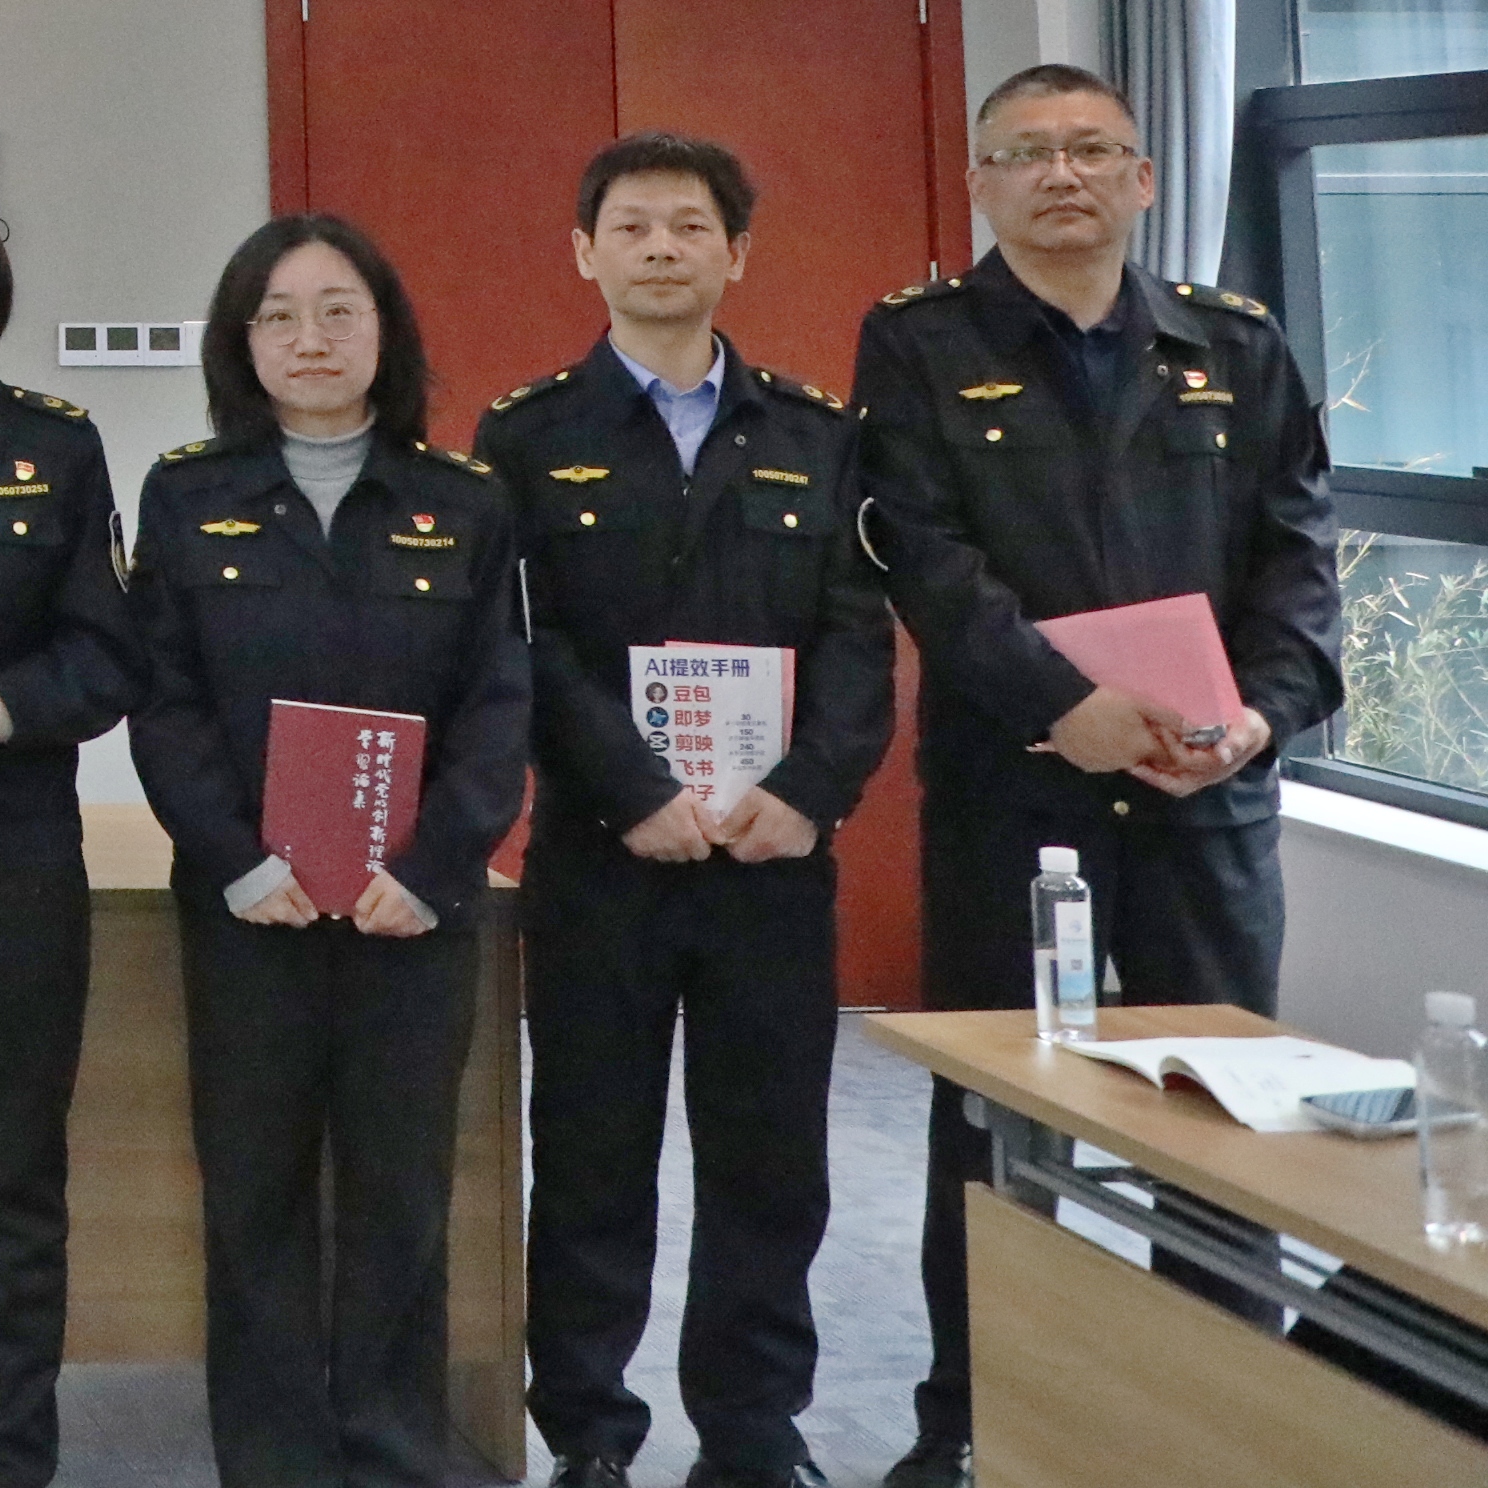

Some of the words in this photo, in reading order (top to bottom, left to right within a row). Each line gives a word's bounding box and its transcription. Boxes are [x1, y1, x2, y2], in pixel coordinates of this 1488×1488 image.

[390, 534, 454, 547] 10050730214
[644, 658, 750, 678] AI提效手册
[673, 685, 711, 702] 豆包
[674, 710, 712, 727] 即梦
[675, 734, 713, 752] 剪映
[675, 759, 714, 776] 飞书
